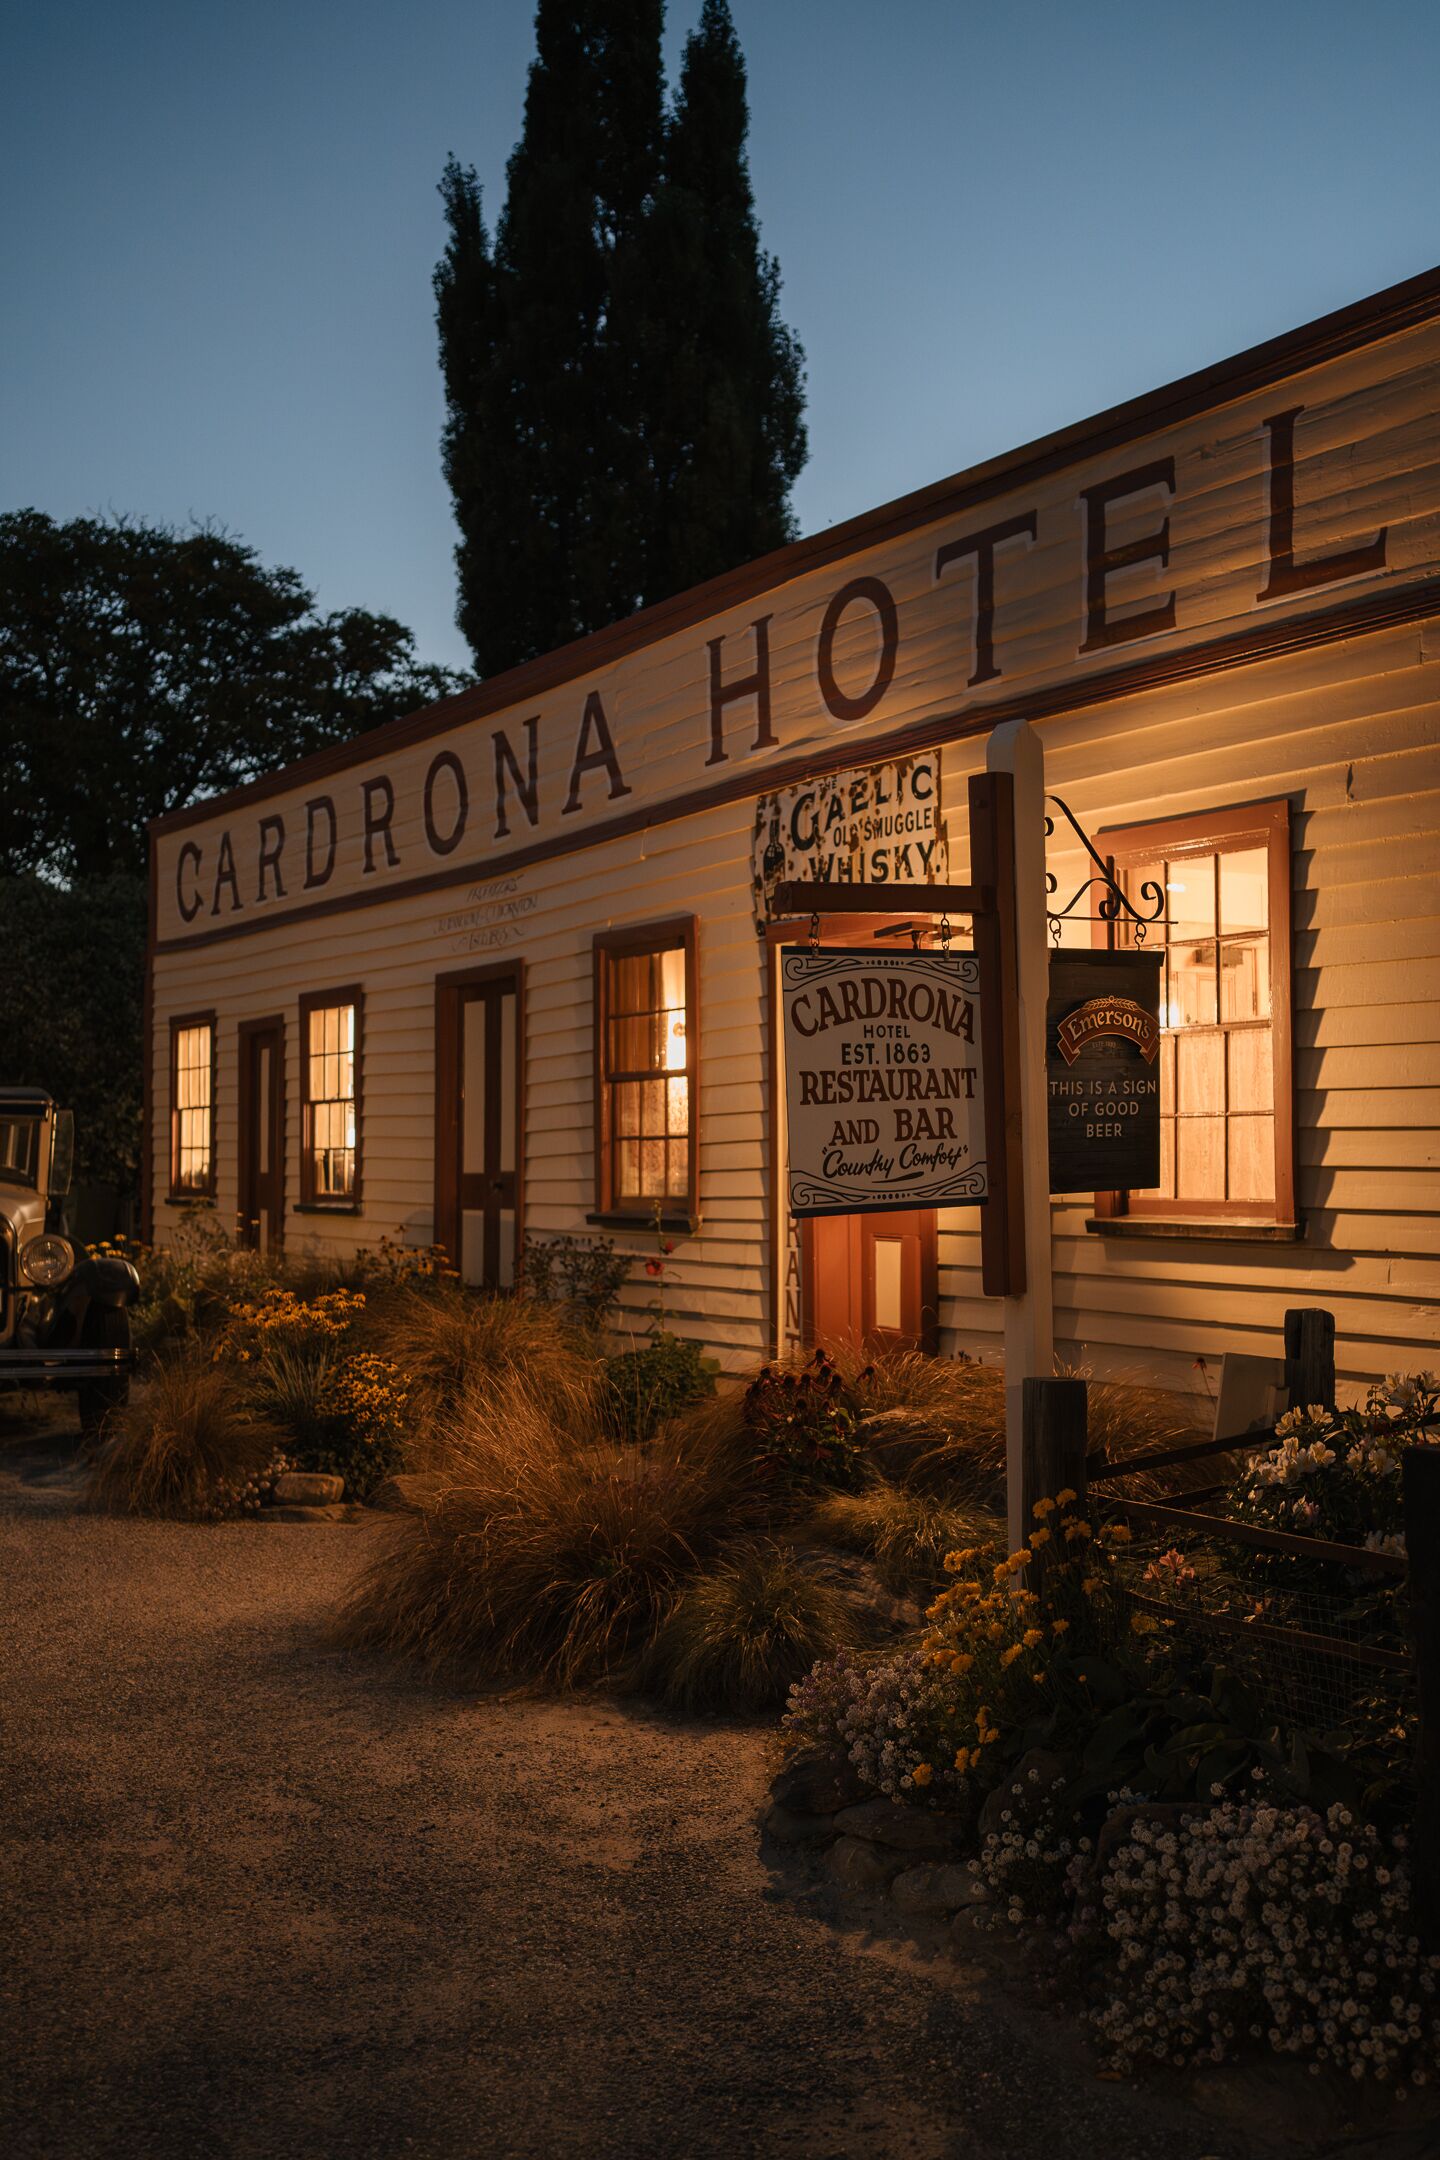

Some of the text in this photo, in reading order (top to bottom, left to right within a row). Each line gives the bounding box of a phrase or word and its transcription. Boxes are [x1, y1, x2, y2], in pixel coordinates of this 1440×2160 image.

[176, 405, 1387, 922] CARDRONA HOTEL
[818, 779, 837, 792] THE
[791, 765, 933, 850] GAELIC
[791, 978, 975, 1045] CARDRONA
[864, 1025, 910, 1038] HOTEL
[1067, 1010, 1151, 1041] Emerson's
[841, 1043, 931, 1065] EST. 1863
[799, 1068, 977, 1105] RESTAURANT
[1050, 1080, 1156, 1096] THIS IS A SIGN
[1068, 1101, 1139, 1117] OF GOOD
[828, 1107, 957, 1147] AND BAR
[1086, 1123, 1122, 1138] BEER
